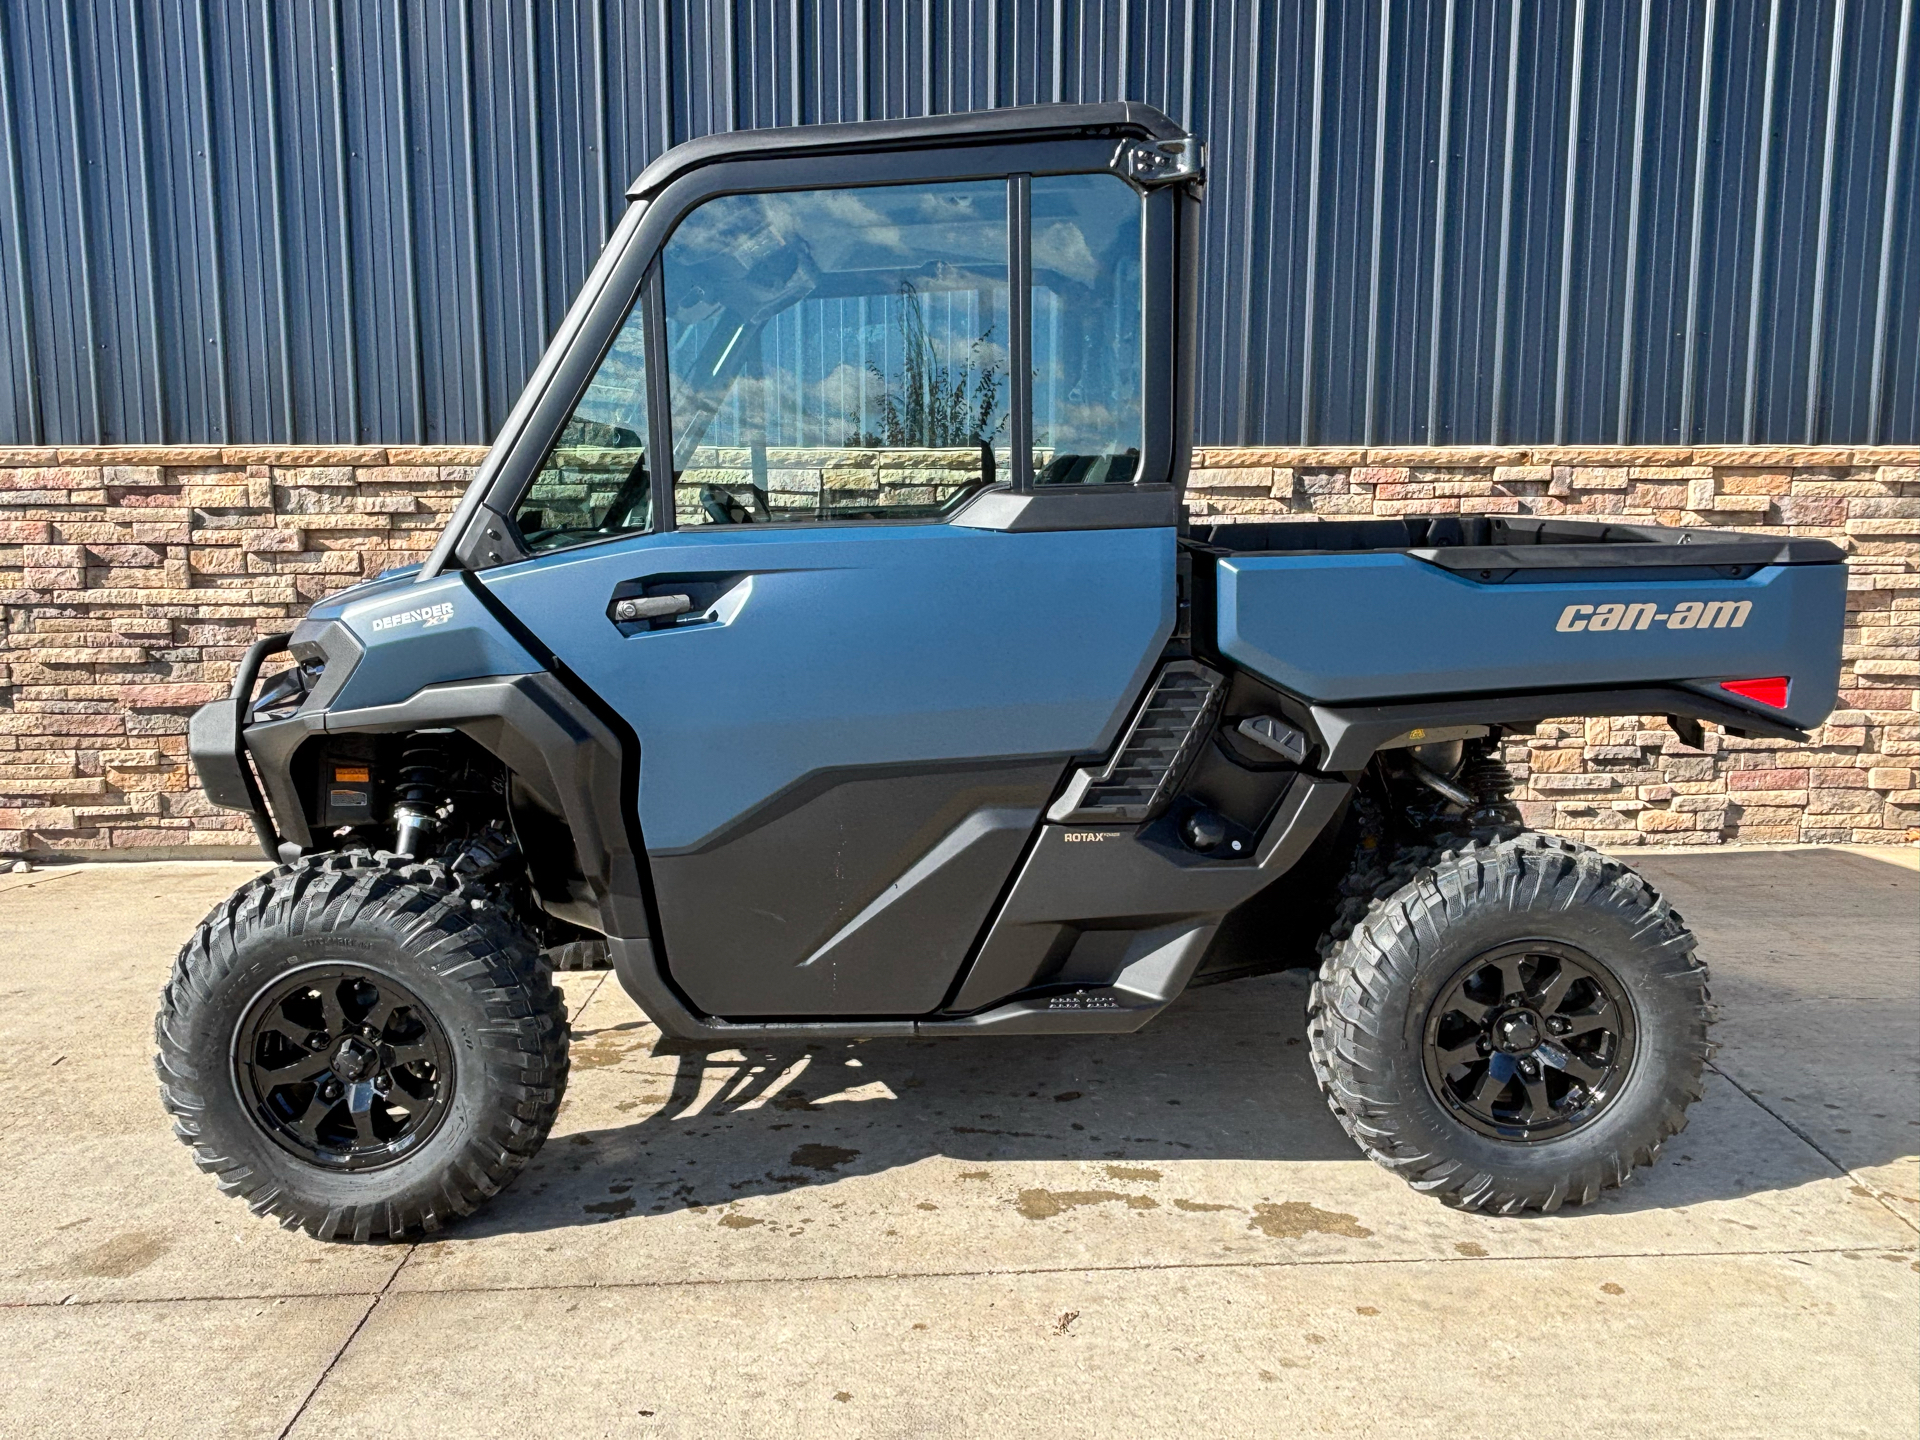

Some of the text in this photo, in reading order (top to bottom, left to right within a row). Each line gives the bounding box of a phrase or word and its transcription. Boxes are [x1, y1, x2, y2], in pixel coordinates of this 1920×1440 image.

[372, 602, 454, 631] DEFENDER
[422, 613, 454, 628] XT
[1555, 600, 1753, 632] can-am
[1064, 832, 1104, 842] ROTAX
